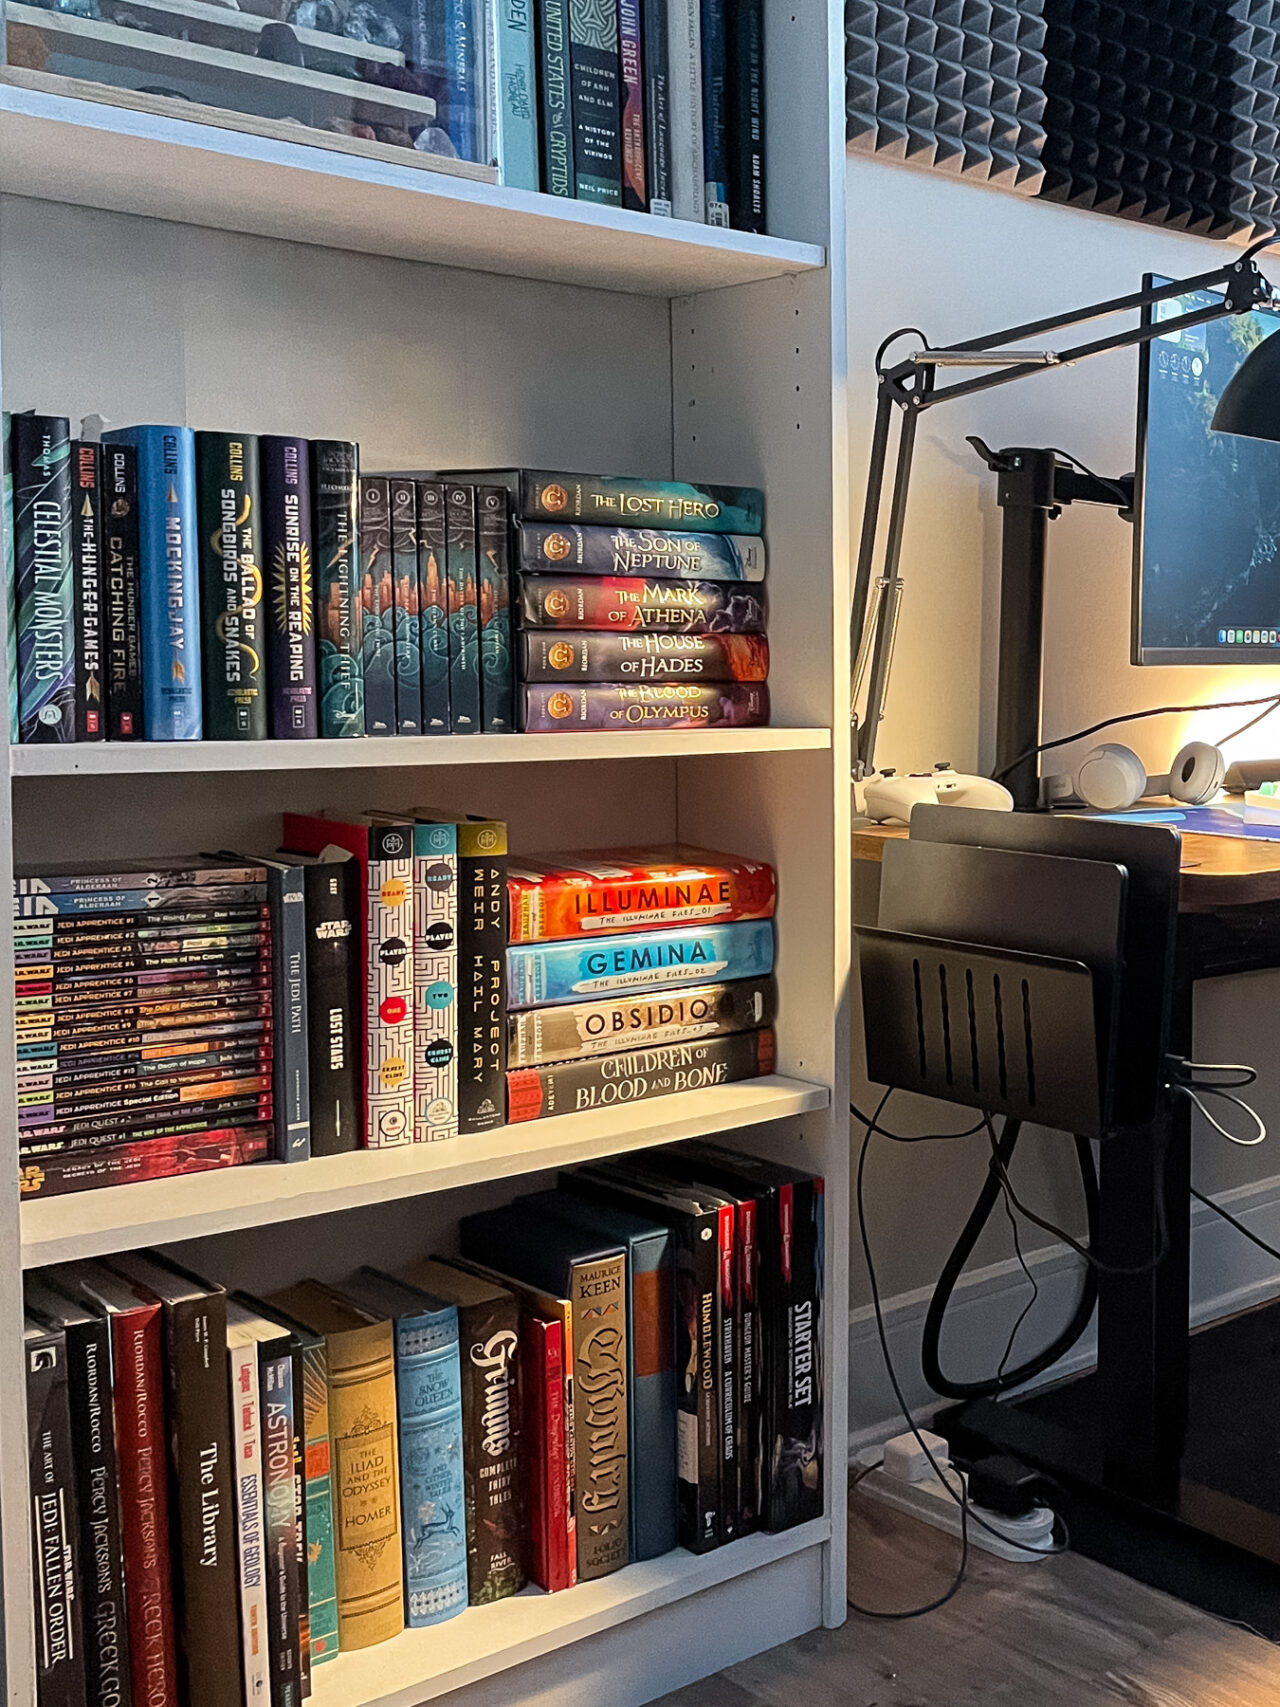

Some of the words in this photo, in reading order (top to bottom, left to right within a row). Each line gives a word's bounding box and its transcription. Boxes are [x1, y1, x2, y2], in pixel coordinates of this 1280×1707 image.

[546, 0, 562, 51] UNITED
[621, 0, 637, 37] JOHN
[574, 63, 615, 79] CHILDREN
[622, 40, 638, 85] GREEN
[548, 53, 565, 110] STATES
[581, 80, 591, 88] OF
[594, 83, 610, 92] ASH
[578, 94, 595, 103] AND
[597, 99, 613, 108] ELM
[585, 125, 615, 137] HISTORY
[596, 139, 610, 148] THE
[550, 131, 568, 196] CRYPTIDS
[584, 149, 613, 160] VIKINGS
[579, 183, 596, 192] NEIL
[597, 187, 618, 196] PRICE
[79, 448, 95, 488] COLLINS
[163, 435, 178, 475] COLLINS
[229, 442, 244, 481] COLLINS
[284, 446, 297, 485] COLLINS
[114, 453, 126, 493] COLLINS
[591, 494, 617, 508] THE
[619, 493, 664, 516] LOST
[668, 498, 720, 519] HERO
[33, 501, 62, 583] CELESTIAL
[83, 519, 94, 538] THE
[221, 489, 238, 582] SONGBIRDS
[241, 527, 252, 549] THE
[285, 495, 300, 562] SUNRISE
[611, 534, 636, 550] THE
[637, 533, 682, 552] SON
[685, 541, 700, 552] OF
[289, 567, 299, 582] ON
[613, 551, 702, 572] NEPTUNE
[82, 543, 98, 616] HUNGER
[110, 537, 125, 642] CATCHING
[165, 517, 185, 649] MOCKINGJAY
[241, 554, 256, 619] BALLAD
[337, 549, 351, 638] LIGHTNING
[226, 588, 237, 611] AND
[290, 585, 300, 606] THE
[615, 590, 640, 604] THE
[642, 585, 703, 605] MARK
[608, 610, 627, 622] OF
[628, 606, 706, 627] ATHENA
[31, 591, 66, 680] MONSTERS
[84, 617, 99, 671] GAMES
[245, 624, 255, 640] OF
[289, 611, 304, 681] REAPING
[618, 636, 643, 650] THE
[645, 633, 705, 651] HOUSE
[225, 616, 240, 682] SNAKES
[112, 649, 127, 695] FIRE
[339, 643, 351, 689] THIEF
[620, 662, 638, 673] OF
[640, 656, 703, 677] HADES
[616, 688, 637, 700] THE
[638, 686, 702, 703] BLOOD
[609, 709, 624, 719] OF
[626, 704, 709, 723] OLYMPUS
[474, 868, 484, 931] WEIR
[490, 868, 500, 930] ANDY
[576, 881, 730, 914] ILLUMINAE
[320, 920, 350, 931] STAR
[600, 917, 615, 925] THE
[623, 911, 665, 922] ILLUMINAE
[673, 907, 711, 917] FILES_01
[316, 928, 350, 939] WARS
[426, 933, 453, 941] PLAYER
[290, 952, 300, 975] THE
[380, 948, 407, 956] PLAYER
[587, 941, 707, 975] GEMINA
[288, 978, 301, 1002] JEDI
[473, 956, 484, 1013] HAIL
[593, 981, 609, 989] THE
[616, 973, 659, 985] ILLUMINAE
[666, 968, 706, 978] FILES_02
[291, 1005, 301, 1033] PATH
[329, 1008, 343, 1034] LOST
[490, 960, 500, 1072] PROJECT
[585, 999, 708, 1035] OBSIDIO
[330, 1036, 344, 1070] STARS
[473, 1027, 484, 1083] MARY
[591, 1040, 607, 1048] THE
[614, 1033, 658, 1045] ILLUMINAE
[601, 1047, 692, 1079] CHILDREN
[695, 1048, 709, 1059] OF
[576, 1077, 648, 1109] BLOOD
[651, 1078, 671, 1090] AND
[674, 1062, 728, 1091] BONE
[74, 1100, 122, 1112] APPRENTICE
[123, 1096, 152, 1106] Special
[580, 1265, 621, 1282] MAURICE
[580, 1277, 621, 1298] KEEN
[702, 1292, 713, 1390] HUMBLEWOOD
[723, 1317, 733, 1364] STRIXHAVEN
[744, 1312, 752, 1344] DUNGEON
[794, 1300, 812, 1376] STARTER
[133, 1330, 148, 1438] RIORDAN/ROCCO
[419, 1379, 449, 1396] SNOW
[427, 1368, 444, 1382] THE
[86, 1343, 101, 1453] RIORDAN/ROCCO
[415, 1387, 453, 1407] QUEEN
[724, 1378, 733, 1425] CURRICULUM
[744, 1382, 752, 1404] GUIDE
[795, 1376, 812, 1410] SET
[577, 1327, 626, 1514] Chivalry
[42, 1431, 52, 1449] THE
[360, 1448, 377, 1459] THE
[725, 1436, 734, 1460] CHAOS
[44, 1452, 53, 1469] ART
[137, 1446, 153, 1497] PERCY
[200, 1442, 218, 1485] The
[266, 1402, 291, 1527] ASTRONOMY
[351, 1455, 384, 1474] ILIAD
[480, 1457, 517, 1479] COMPLETE
[45, 1471, 54, 1483] OF
[90, 1466, 107, 1514] PERCY
[342, 1476, 392, 1498] ODYSSEY
[347, 1473, 370, 1485] AND
[373, 1466, 388, 1478] THE
[489, 1475, 511, 1492] FAIRY
[241, 1474, 259, 1532] ESSENTIALS
[489, 1490, 512, 1506] TALES
[41, 1493, 58, 1534] JEDI:
[200, 1488, 220, 1566] Library
[345, 1505, 392, 1528] HOMER
[243, 1531, 260, 1545] OF
[44, 1535, 61, 1598] FALLEN
[63, 1545, 72, 1569] STAR
[243, 1545, 261, 1590] GEOLOGY
[490, 1552, 507, 1562] FALL
[490, 1557, 512, 1569] RIVER
[64, 1570, 74, 1600] WARS
[49, 1603, 67, 1664] ORDER
[95, 1601, 118, 1673] GREEK
